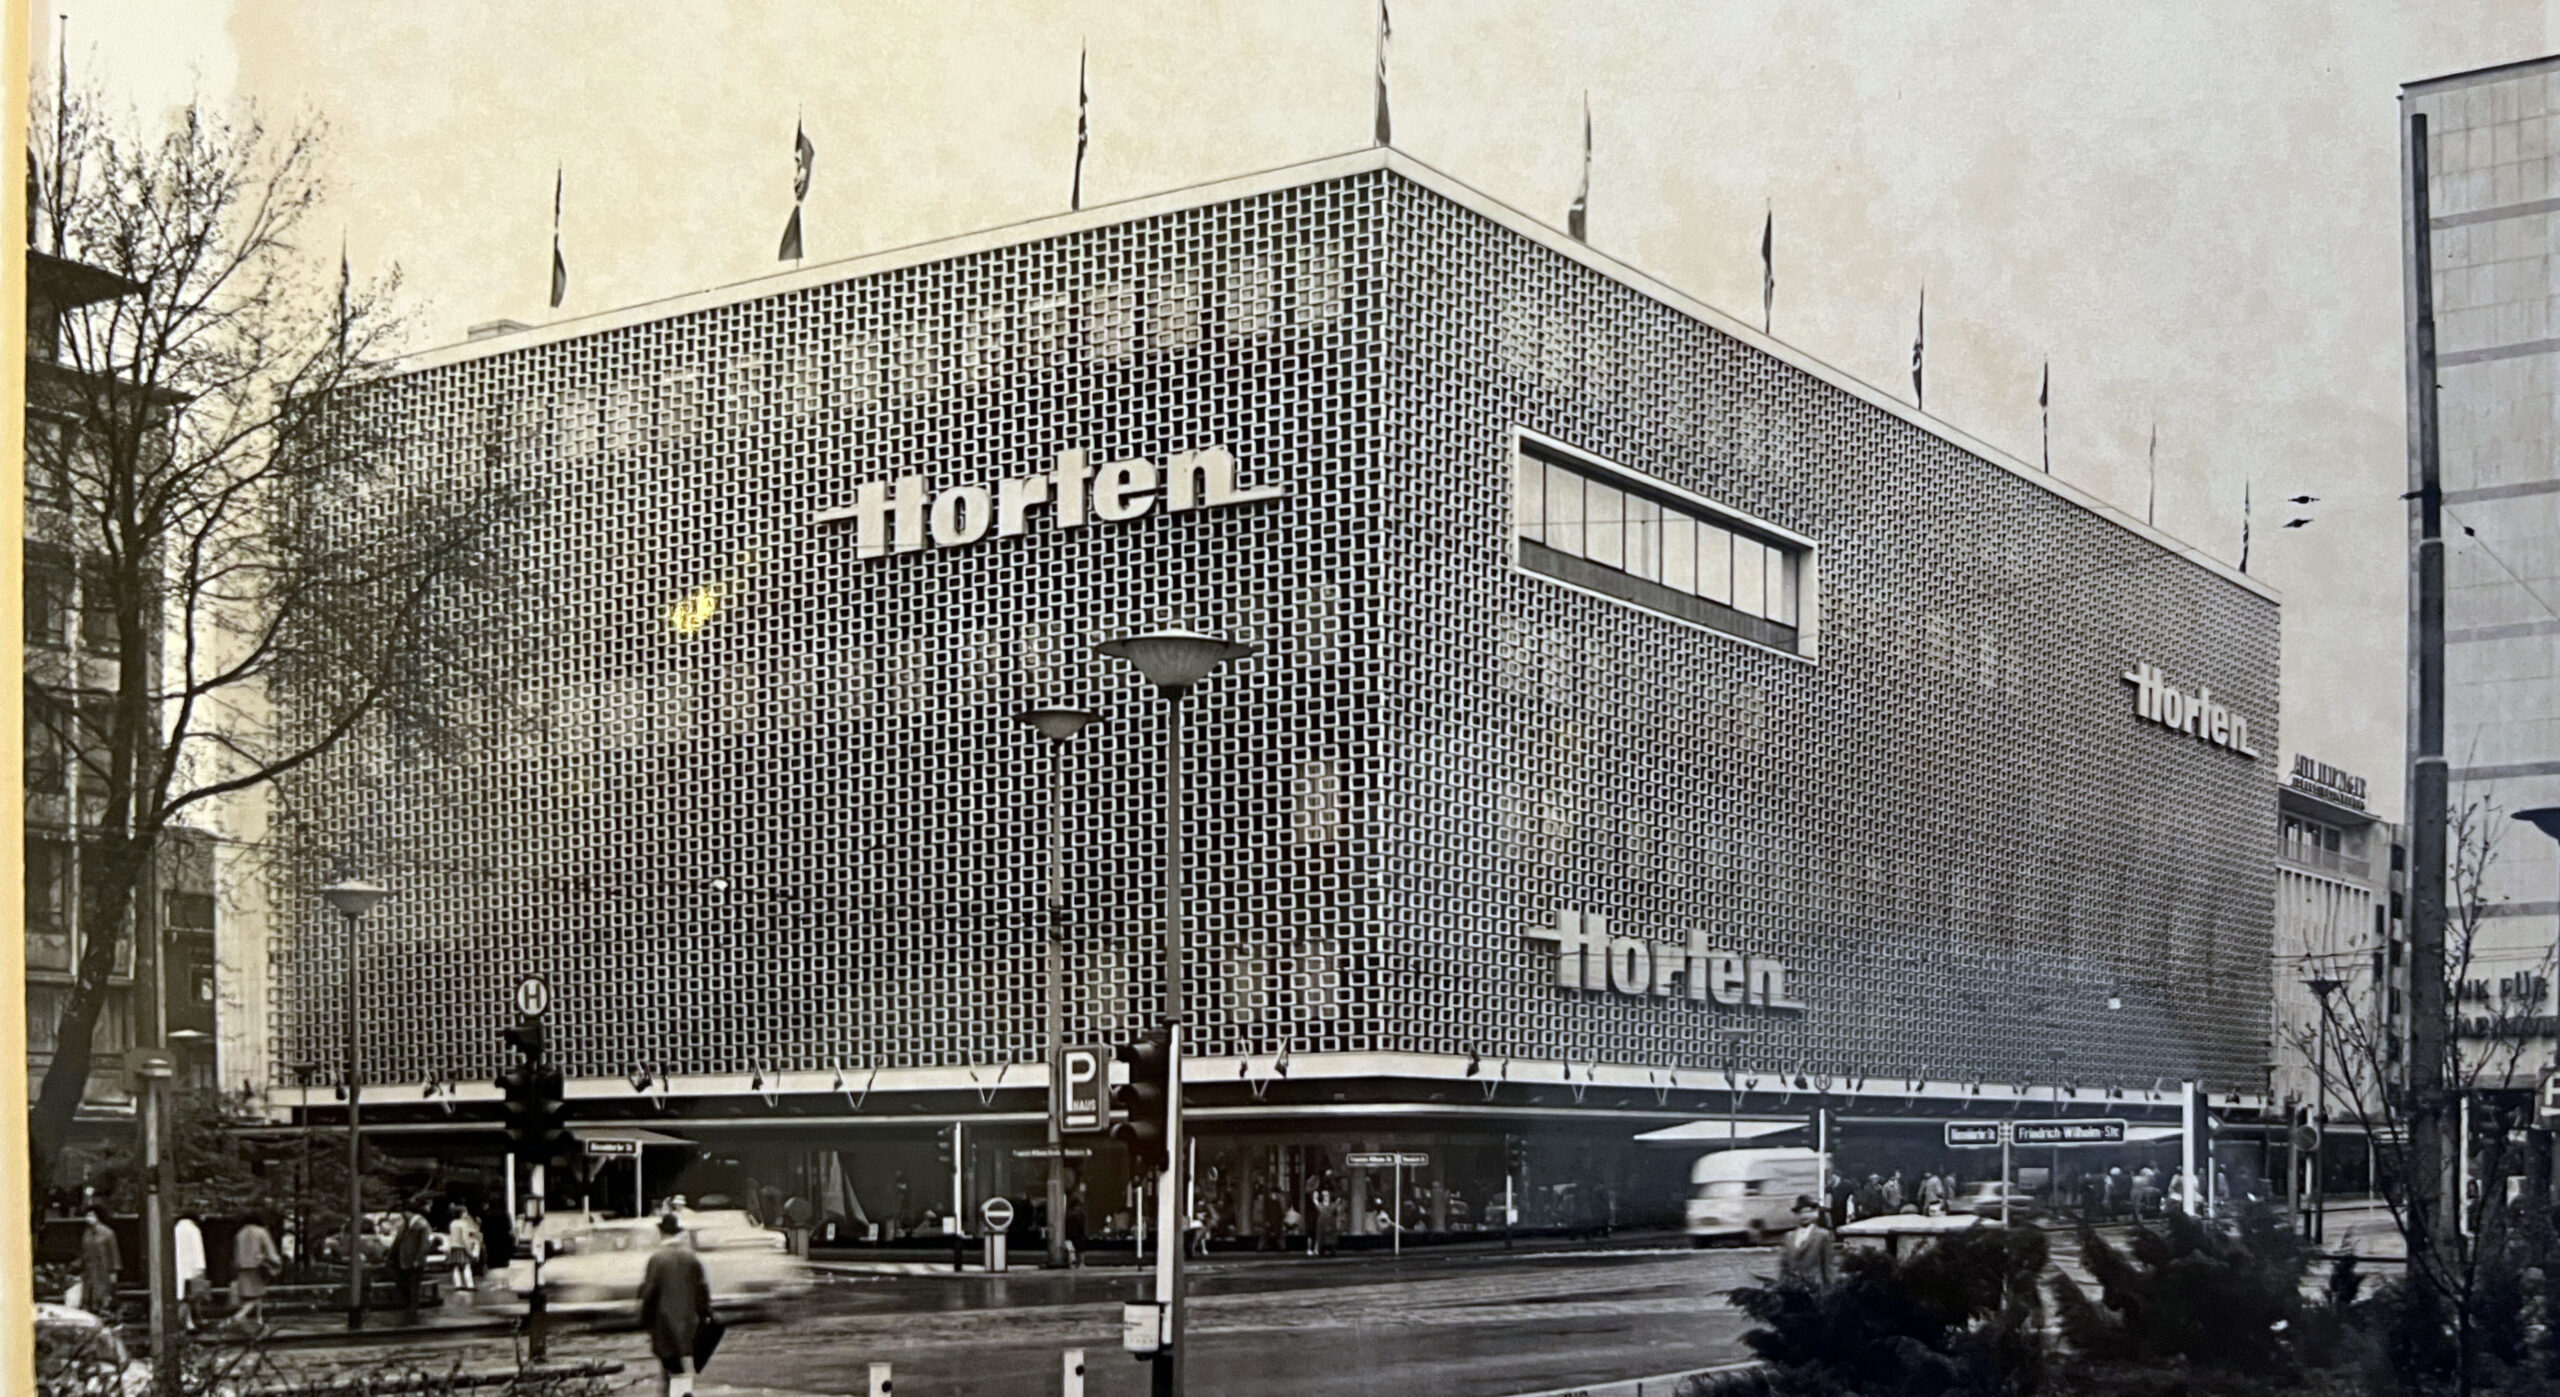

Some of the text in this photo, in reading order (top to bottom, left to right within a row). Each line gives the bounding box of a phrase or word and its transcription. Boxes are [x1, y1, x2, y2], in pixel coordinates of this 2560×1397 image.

[812, 446, 1291, 559] Horten
[2122, 662, 2260, 759] Horten
[523, 983, 542, 1009] H
[1524, 909, 1808, 1009] Horten
[1066, 1052, 1096, 1112] P
